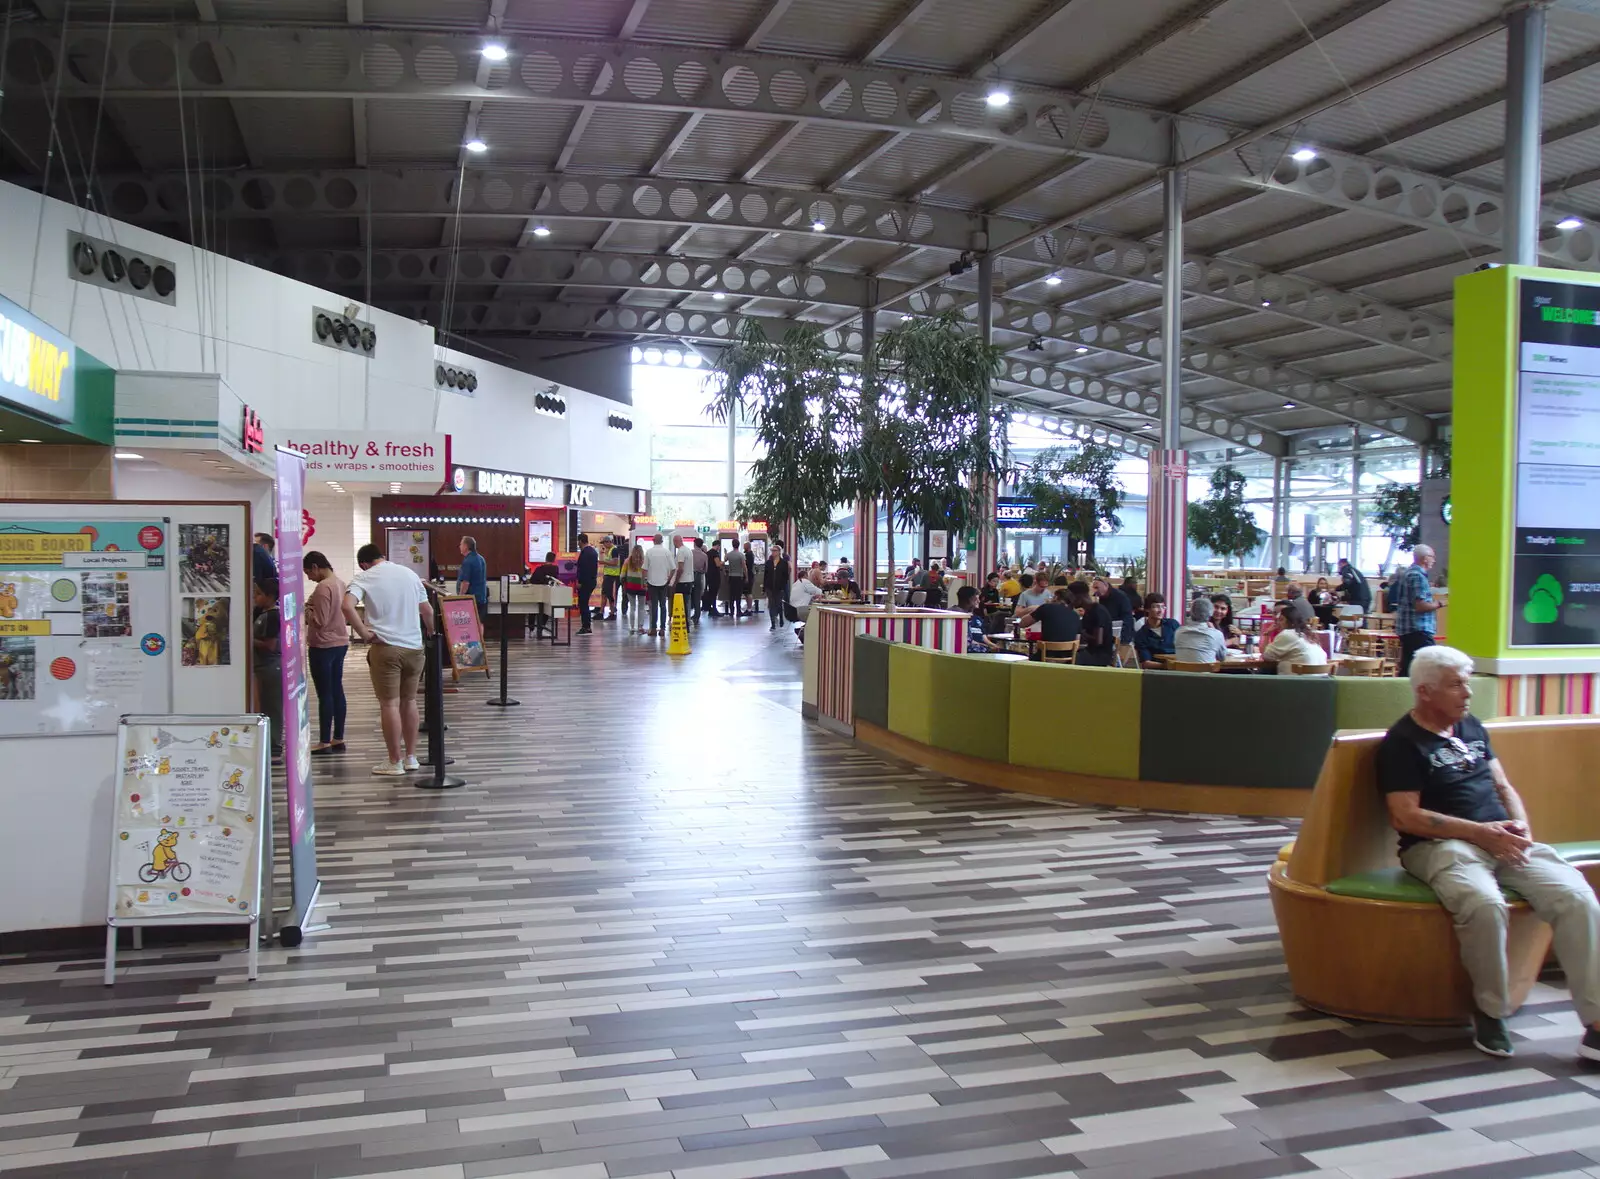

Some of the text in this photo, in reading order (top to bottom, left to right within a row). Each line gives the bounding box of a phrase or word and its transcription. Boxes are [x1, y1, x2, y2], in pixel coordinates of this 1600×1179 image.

[287, 440, 434, 459] healthy & fresh
[334, 463, 368, 471] wraps
[379, 463, 434, 472] smoothies
[478, 471, 525, 497] BURGER
[527, 477, 554, 499] KING
[569, 483, 595, 507] KFC
[41, 538, 85, 551] BOARD
